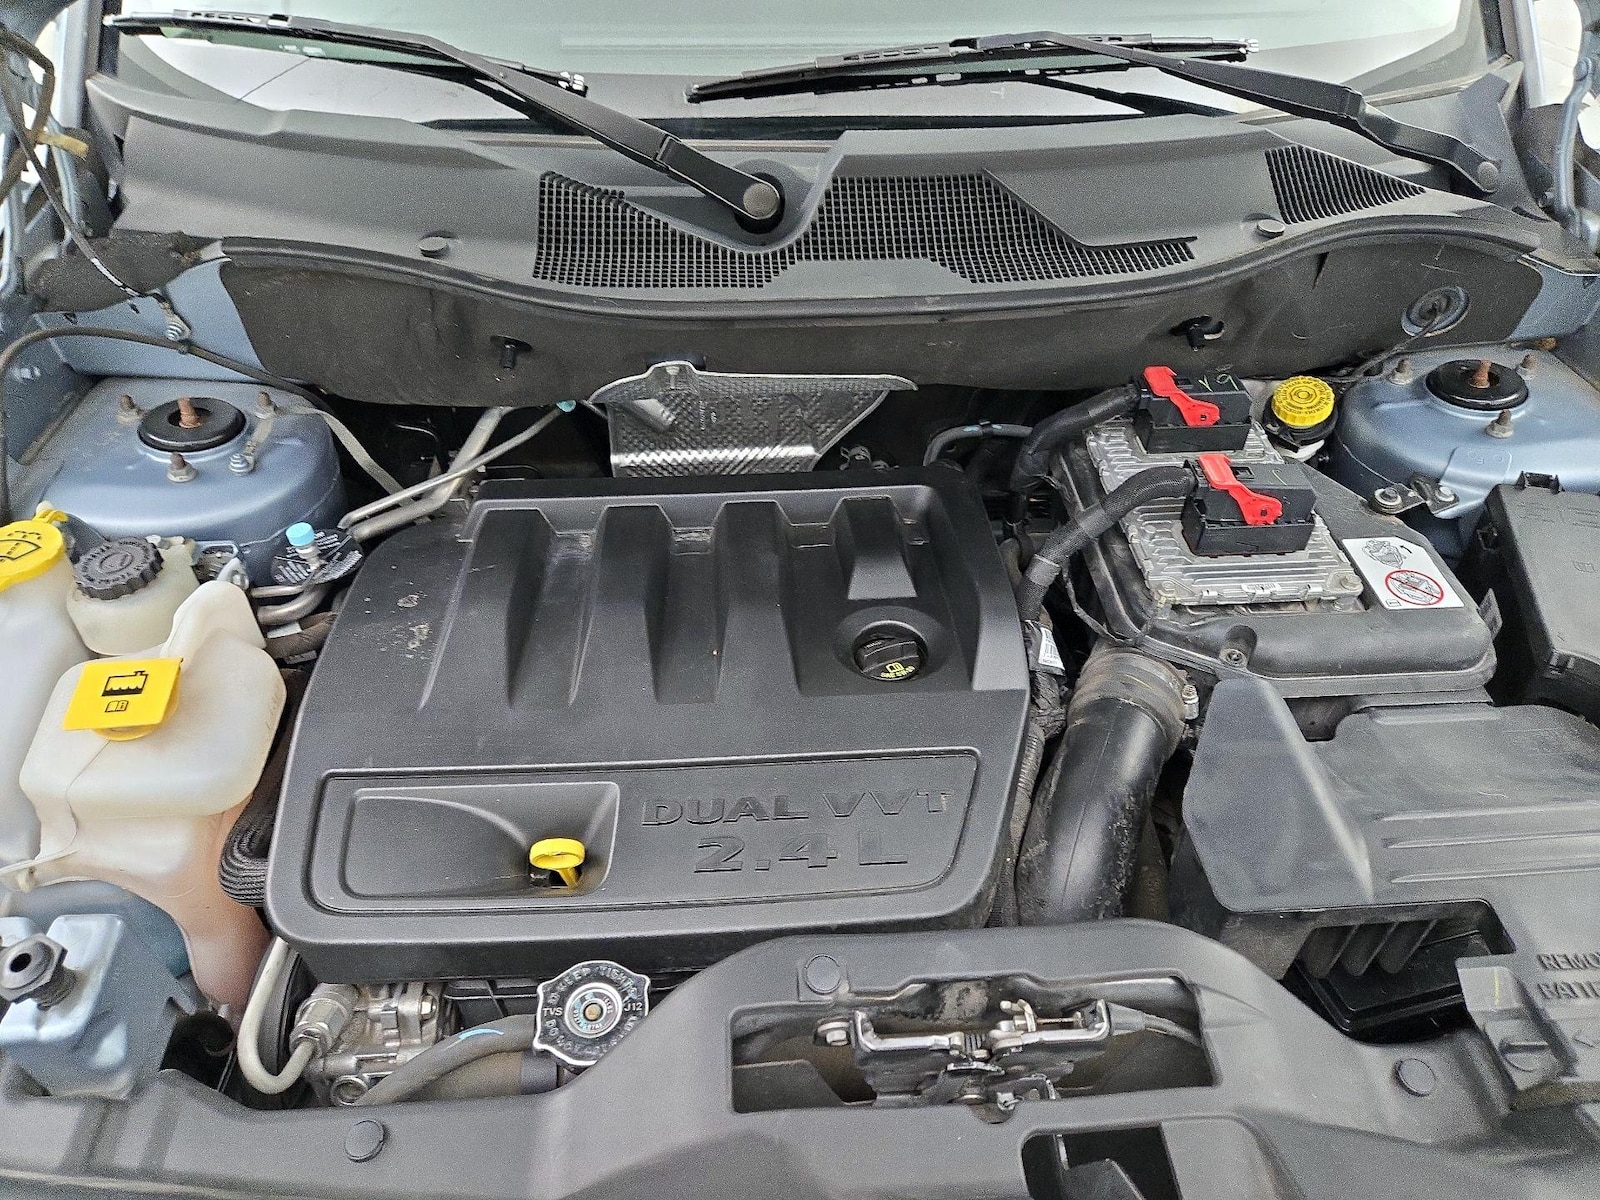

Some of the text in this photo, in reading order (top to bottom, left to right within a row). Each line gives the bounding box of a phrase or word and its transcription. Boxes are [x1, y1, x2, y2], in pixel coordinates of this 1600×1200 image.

[641, 790, 951, 826] DUAL VVT
[1536, 951, 1600, 970] REMO
[556, 966, 591, 992] KEEP
[542, 1006, 563, 1017] TVS
[623, 1002, 642, 1012] J12
